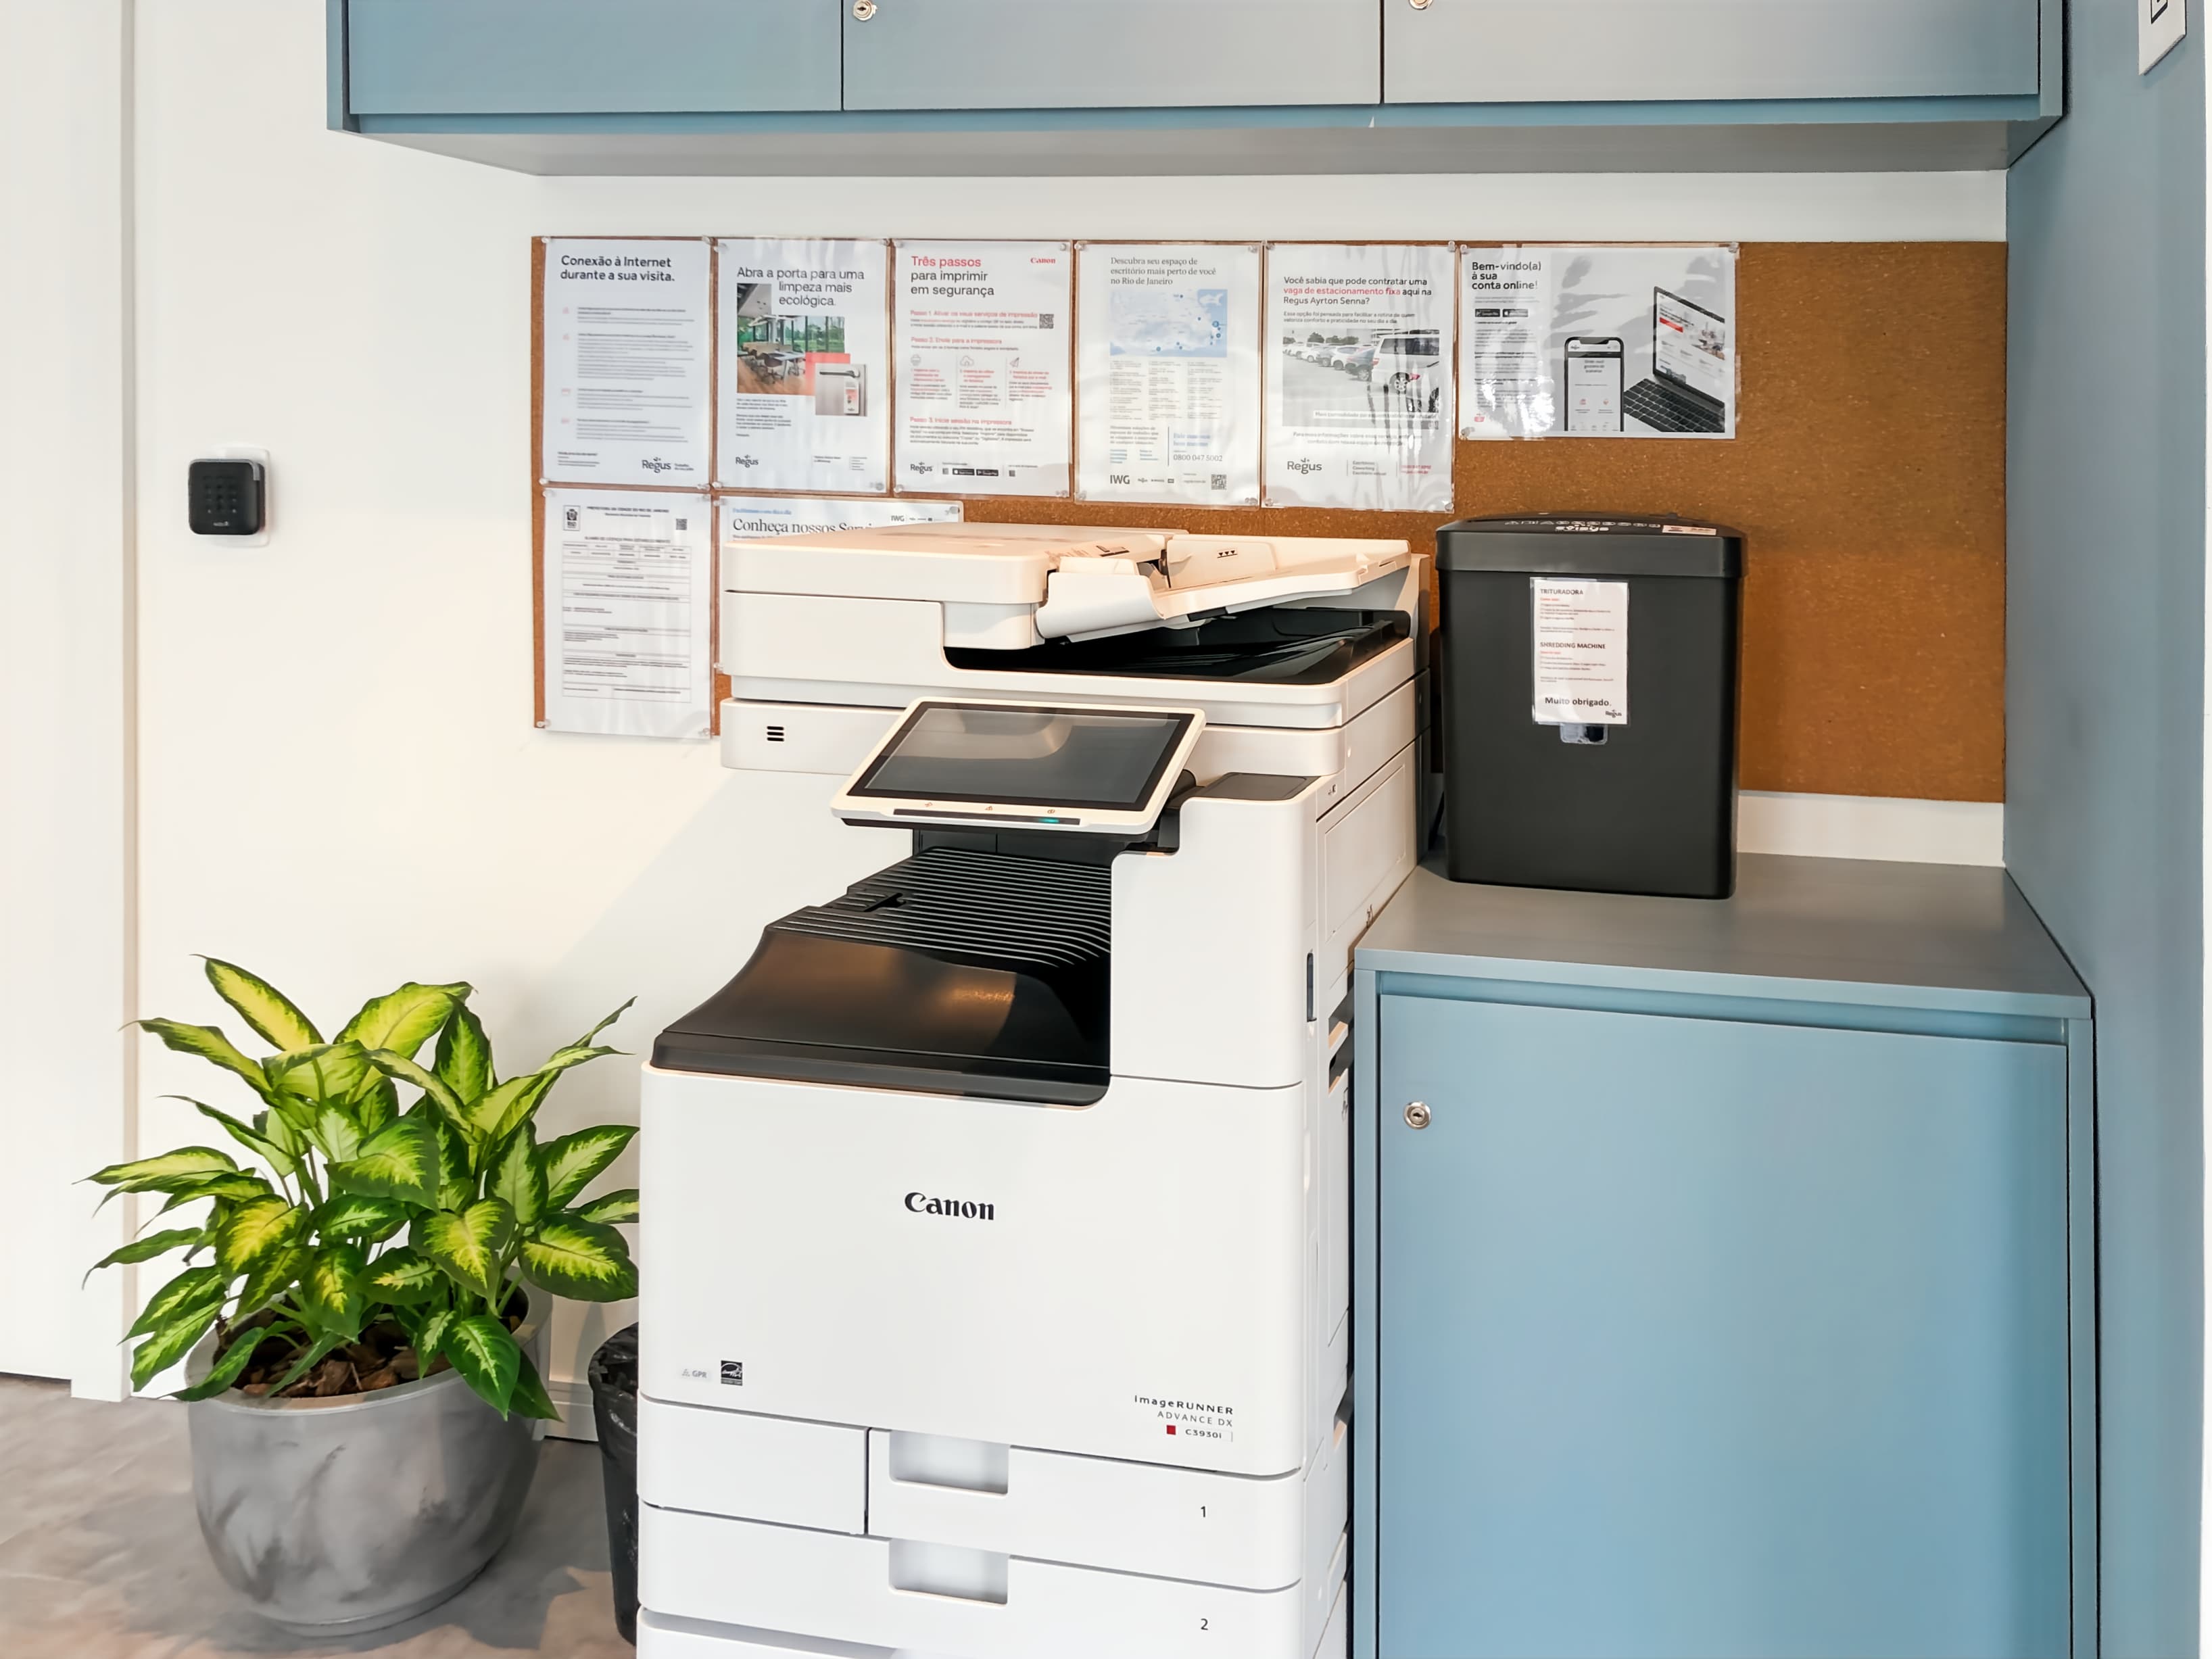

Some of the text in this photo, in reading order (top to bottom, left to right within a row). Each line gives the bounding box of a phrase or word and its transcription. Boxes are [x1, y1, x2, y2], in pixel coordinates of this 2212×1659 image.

[561, 255, 671, 268] Conexão à Internet
[911, 256, 982, 268] Três passos
[1111, 257, 1145, 265] Descubra
[1161, 258, 1187, 266] espaço
[1188, 257, 1198, 265] de
[1472, 261, 1541, 271] Bem-vindo(a)
[560, 270, 675, 281] durante a sua visita.
[737, 266, 763, 278] Abra
[777, 269, 807, 280] porta
[811, 270, 836, 281] para
[839, 271, 865, 280] uma
[911, 270, 988, 283] para imprimir
[1167, 268, 1187, 276] perto
[1147, 277, 1173, 286] Janeiro
[1284, 276, 1304, 285] Você
[1328, 279, 1344, 287] que
[1345, 277, 1366, 287] pode
[1472, 280, 1538, 289] conta online!
[779, 281, 852, 294] limpeza mais
[911, 286, 994, 297] em segurança
[1402, 288, 1420, 297] aqui
[1284, 297, 1309, 306] Regus
[1310, 297, 1338, 306] Ayrton
[642, 460, 671, 473] Regus
[736, 457, 759, 468] Regus
[1287, 460, 1322, 475] Regus
[911, 464, 932, 475] Regus
[1110, 475, 1130, 484] IWG
[733, 519, 788, 535] Conheça
[792, 523, 836, 534] nossos
[1572, 698, 1612, 707] obrigado.
[905, 1192, 994, 1220] Canon
[692, 1370, 707, 1378] GPR
[1157, 1410, 1232, 1428] ADVANCE DX
[1201, 1506, 1206, 1518] 1
[1201, 1618, 1208, 1631] 2
